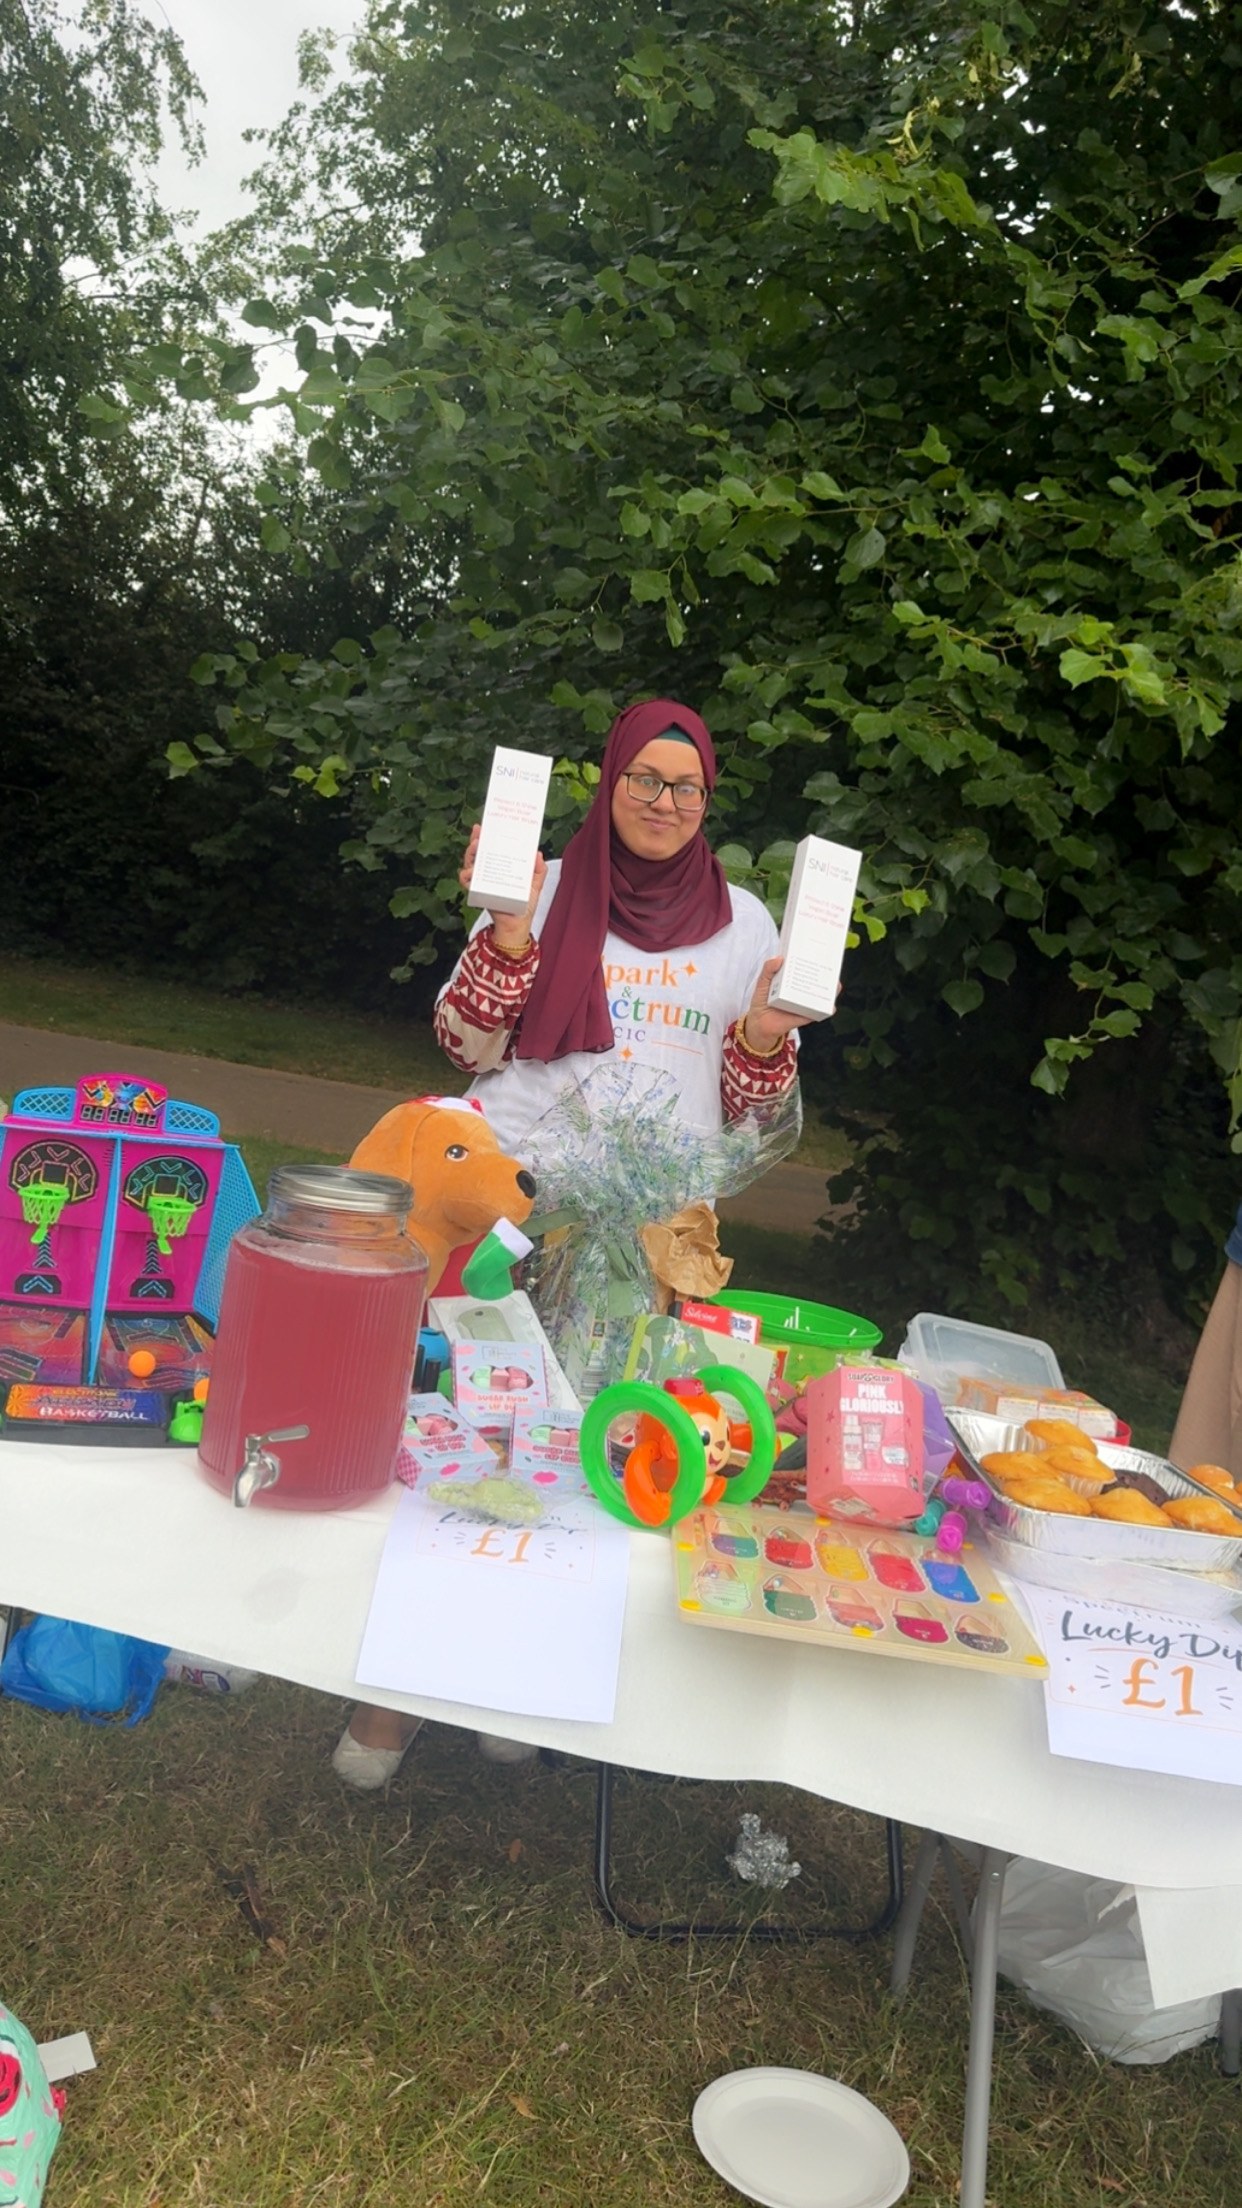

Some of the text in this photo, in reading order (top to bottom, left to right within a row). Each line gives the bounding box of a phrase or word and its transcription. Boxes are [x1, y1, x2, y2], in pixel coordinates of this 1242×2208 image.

[496, 764, 515, 777] SNI
[808, 857, 827, 873] SNI
[600, 955, 679, 990] park
[621, 986, 633, 998] &
[610, 996, 711, 1036] ctrum
[613, 1026, 646, 1042] CIC
[857, 1383, 887, 1400] PINK
[40, 1407, 148, 1419] BASKETBALL
[470, 1526, 534, 1564] £1
[1061, 1610, 1177, 1659] Lucky
[1121, 1656, 1204, 1716] £1
